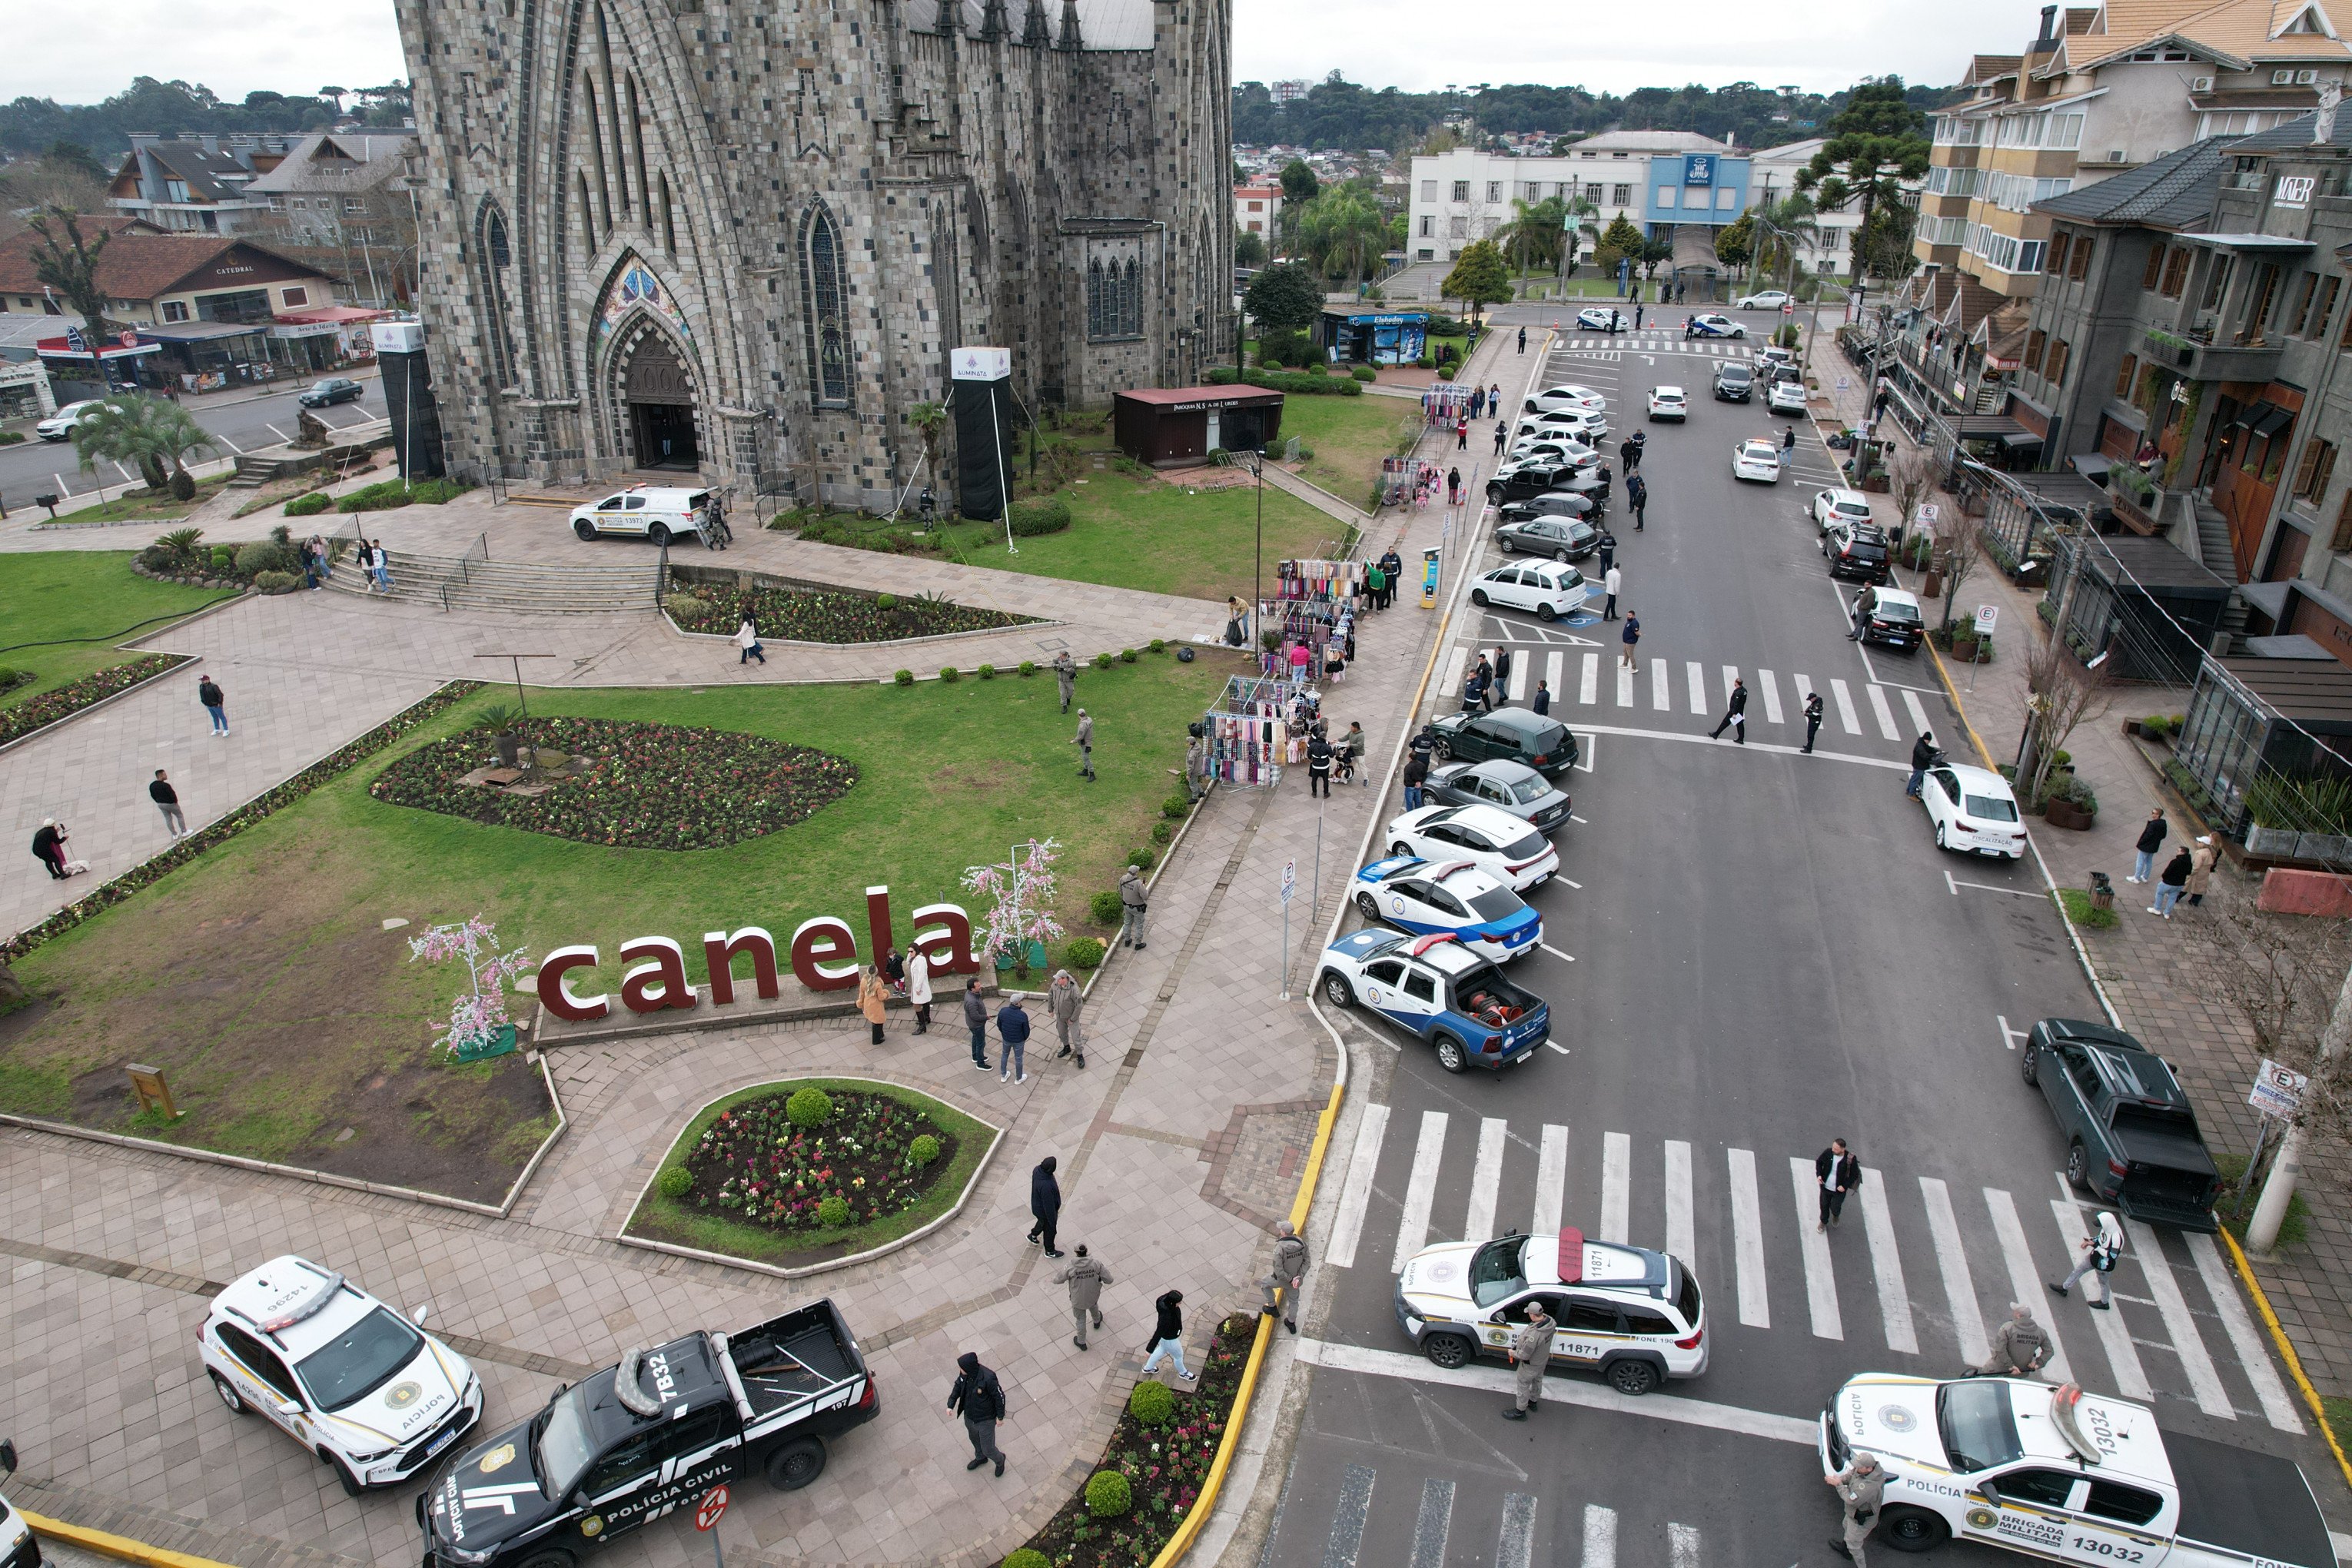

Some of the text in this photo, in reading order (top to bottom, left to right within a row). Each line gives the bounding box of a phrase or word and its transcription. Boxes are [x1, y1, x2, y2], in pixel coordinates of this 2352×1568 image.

[216, 265, 254, 275] CATEDRAL
[1626, 331, 1673, 340] PARE
[1983, 610, 1992, 618] E
[1972, 835, 2013, 846] FISCALIZAÇÃO
[537, 885, 981, 1021] canela
[2276, 1071, 2290, 1087] E
[1591, 1250, 1603, 1277] 11871
[267, 1285, 308, 1312] 14296
[1558, 1342, 1599, 1355] 11871
[649, 1353, 678, 1404] 7B32
[831, 1399, 848, 1411] 197
[314, 1423, 335, 1441] POLÍCIA
[2087, 1407, 2117, 1457] 13032
[607, 1463, 733, 1523] POLÍCIA CIVIL
[1907, 1479, 1961, 1498] POLÍCIA
[1999, 1520, 2062, 1542] MILITAR
[2001, 1514, 2065, 1536] BRIGADA
[2010, 1530, 2035, 1541] GRANDE
[2046, 1540, 2060, 1548] SUL
[2072, 1536, 2144, 1564] 13032
